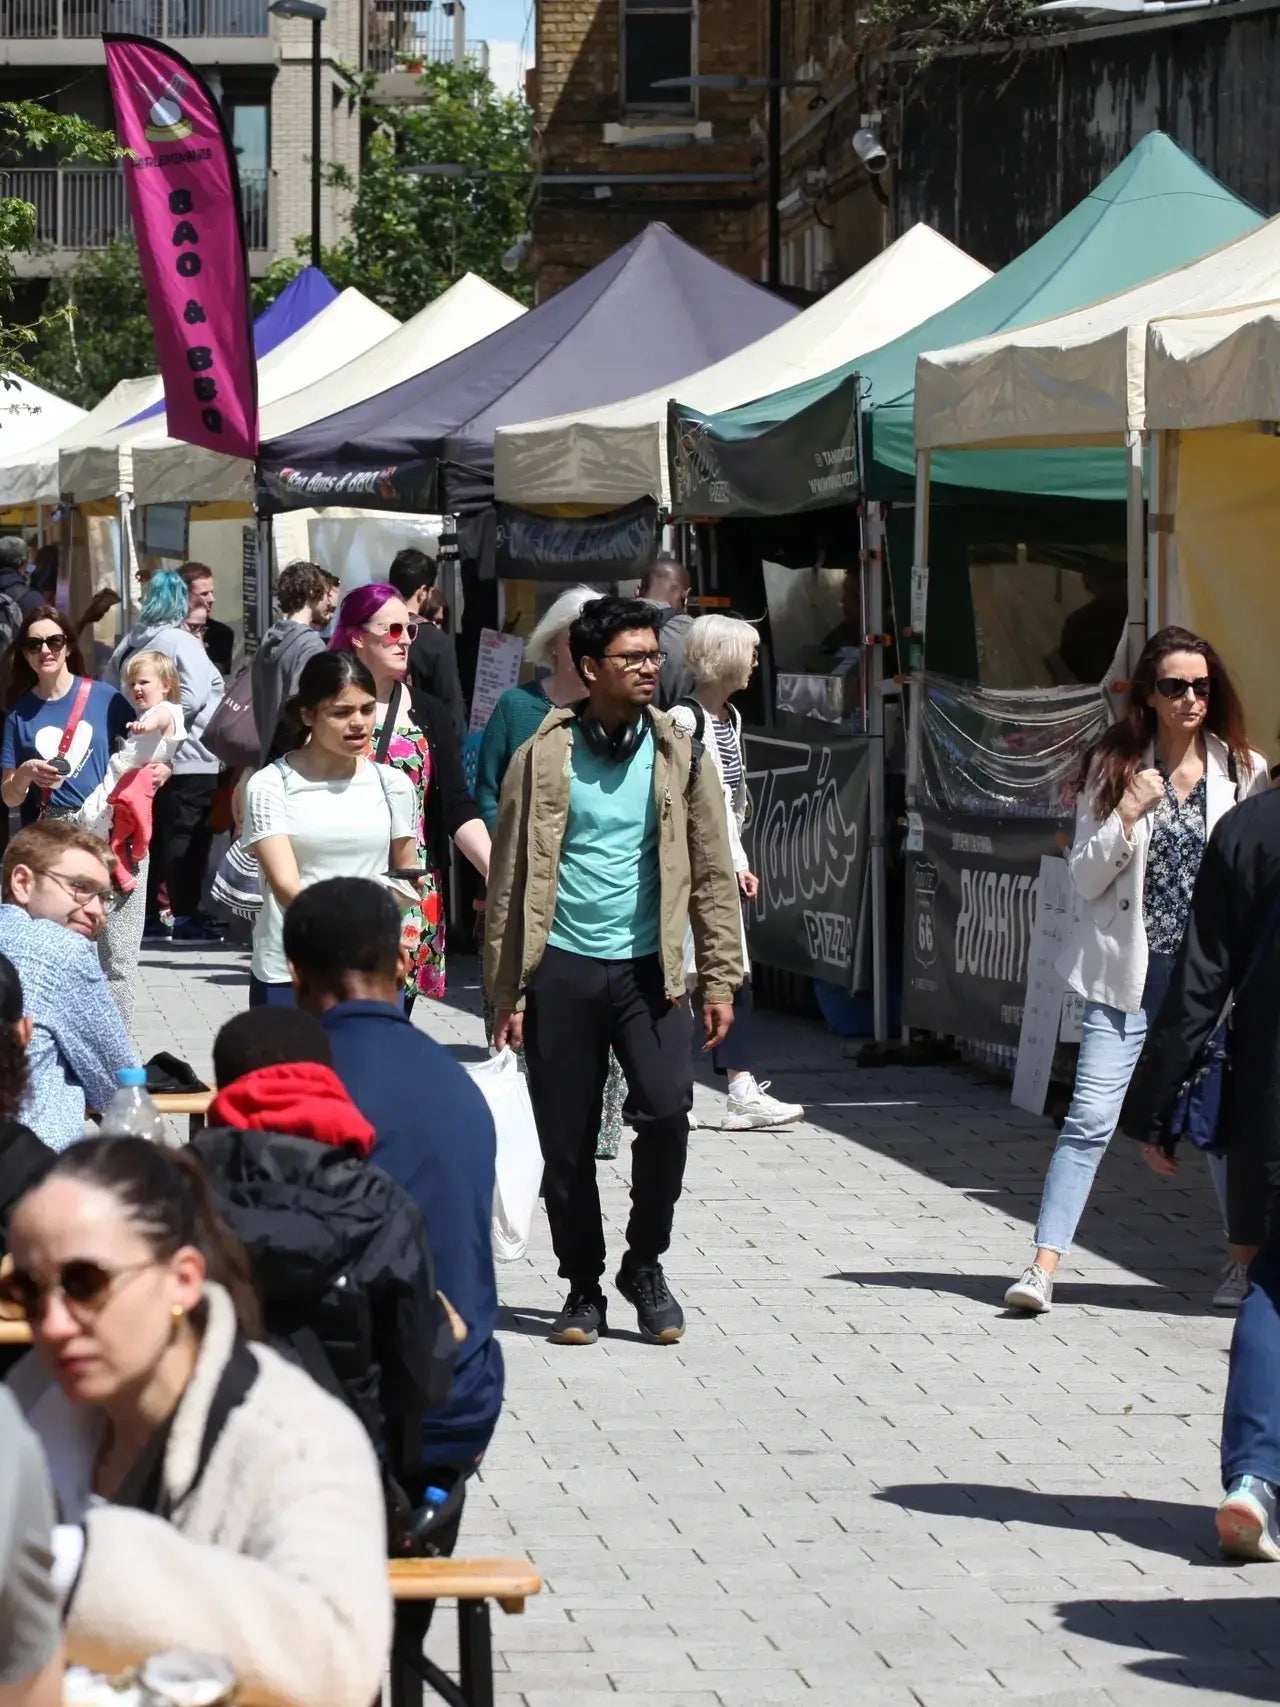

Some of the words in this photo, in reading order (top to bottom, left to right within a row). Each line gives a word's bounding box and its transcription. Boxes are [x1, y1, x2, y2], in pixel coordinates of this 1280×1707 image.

[168, 189, 201, 278] BAO
[184, 299, 207, 325] &
[186, 346, 223, 434] BBQ
[918, 912, 934, 951] 66
